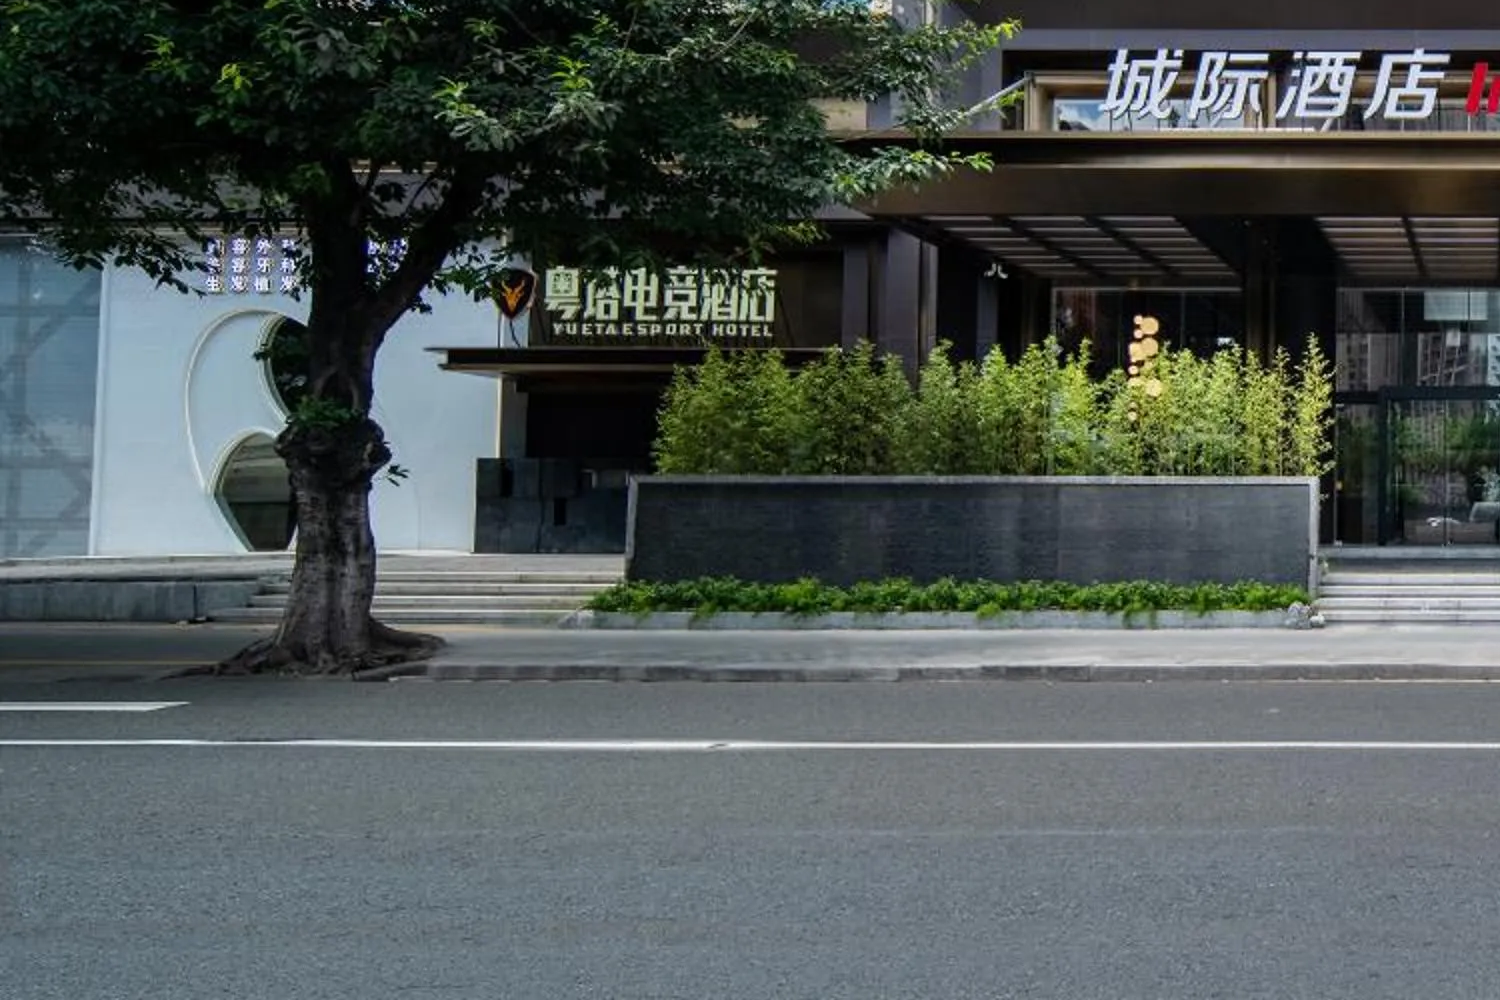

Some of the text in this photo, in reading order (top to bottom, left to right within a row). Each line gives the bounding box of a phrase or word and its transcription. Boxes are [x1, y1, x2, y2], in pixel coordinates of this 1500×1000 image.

[1098, 48, 1451, 120] 城际酒店
[712, 323, 773, 337] HOTEL
